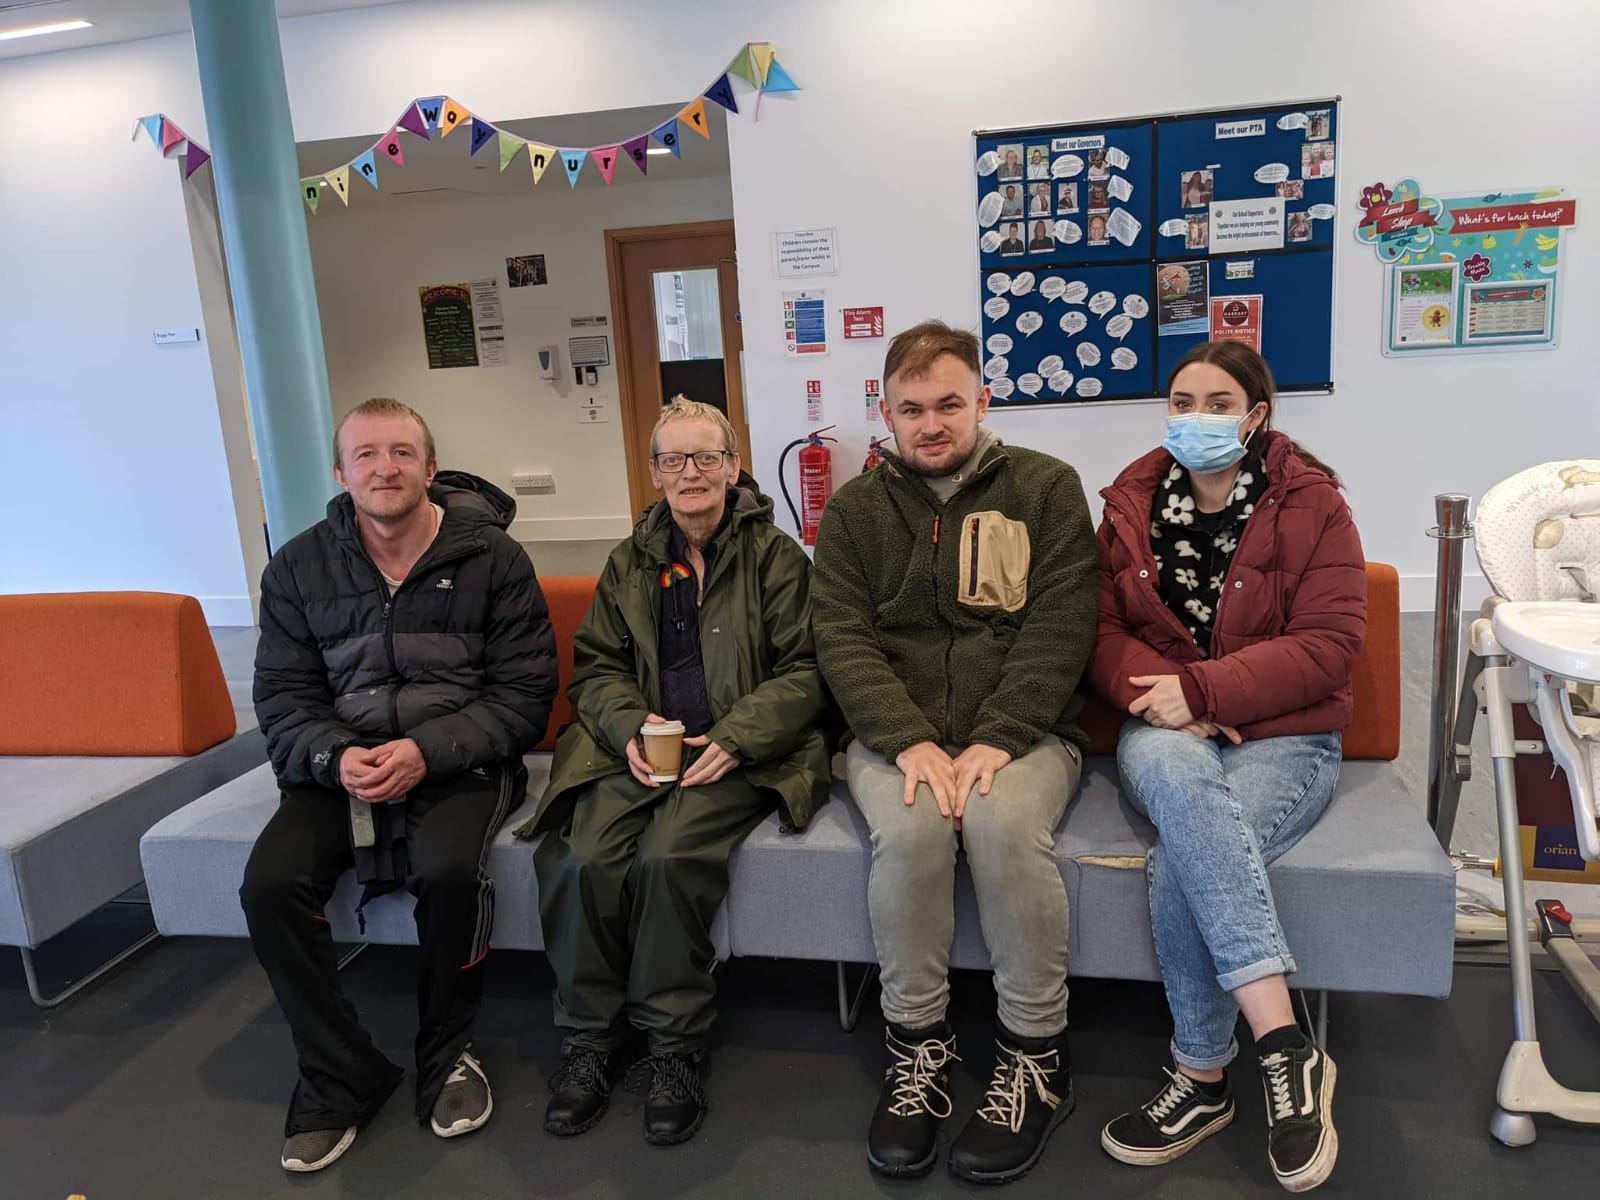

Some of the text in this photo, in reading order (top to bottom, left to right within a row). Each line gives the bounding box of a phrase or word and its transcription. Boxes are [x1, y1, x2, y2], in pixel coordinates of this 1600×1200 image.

[423, 107, 486, 145] way
[534, 87, 733, 171] nursery
[1218, 124, 1263, 136] Meet our PTA
[1056, 139, 1102, 149] Meet our Governors
[1458, 208, 1563, 225] What's for lunch today?
